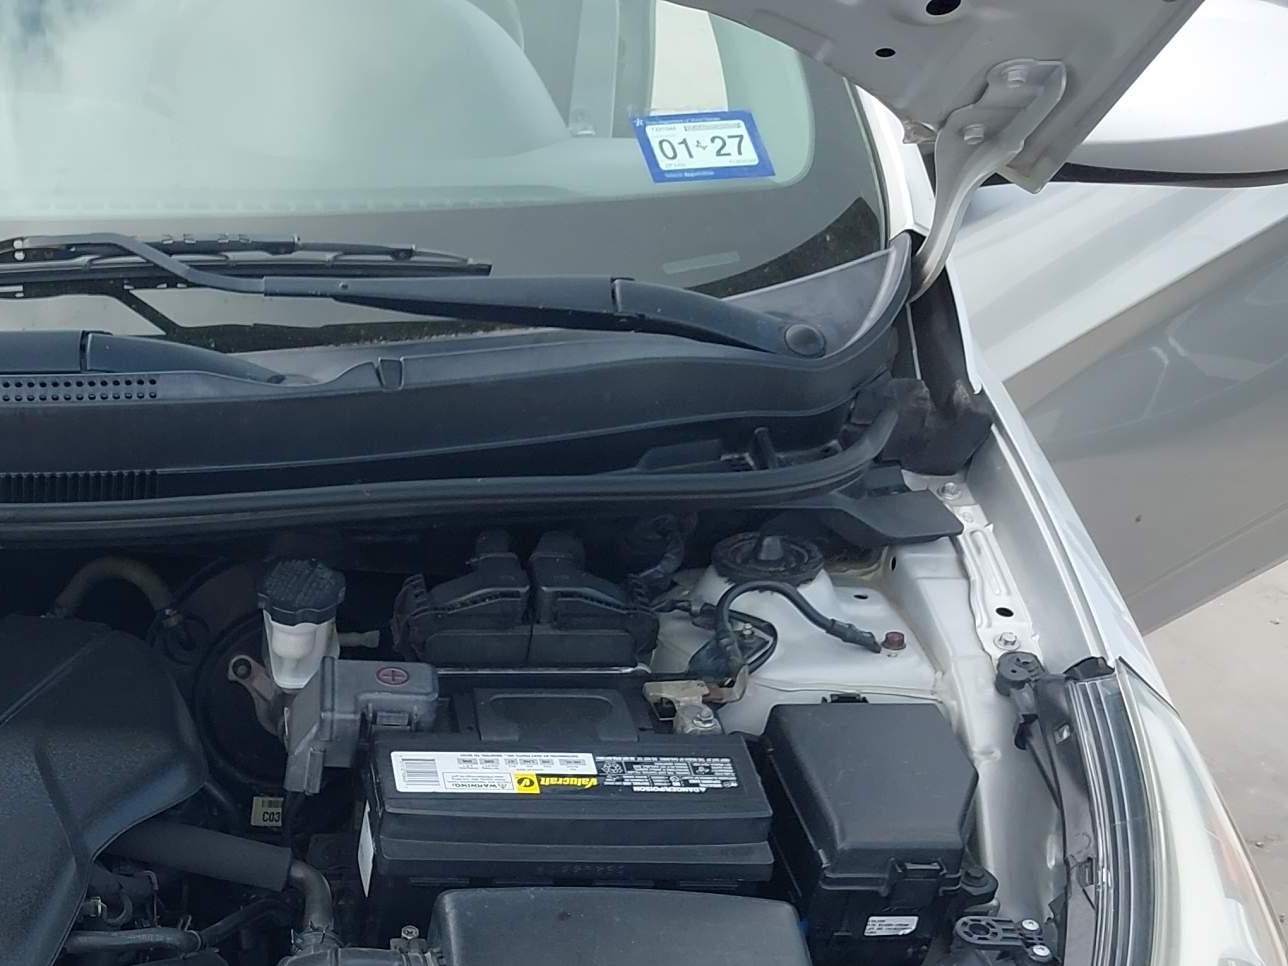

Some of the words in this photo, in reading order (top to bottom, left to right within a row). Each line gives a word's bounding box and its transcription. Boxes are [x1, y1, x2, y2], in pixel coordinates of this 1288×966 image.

[658, 137, 694, 161] 01
[710, 134, 744, 157] 27
[539, 776, 599, 790] Valucraft
